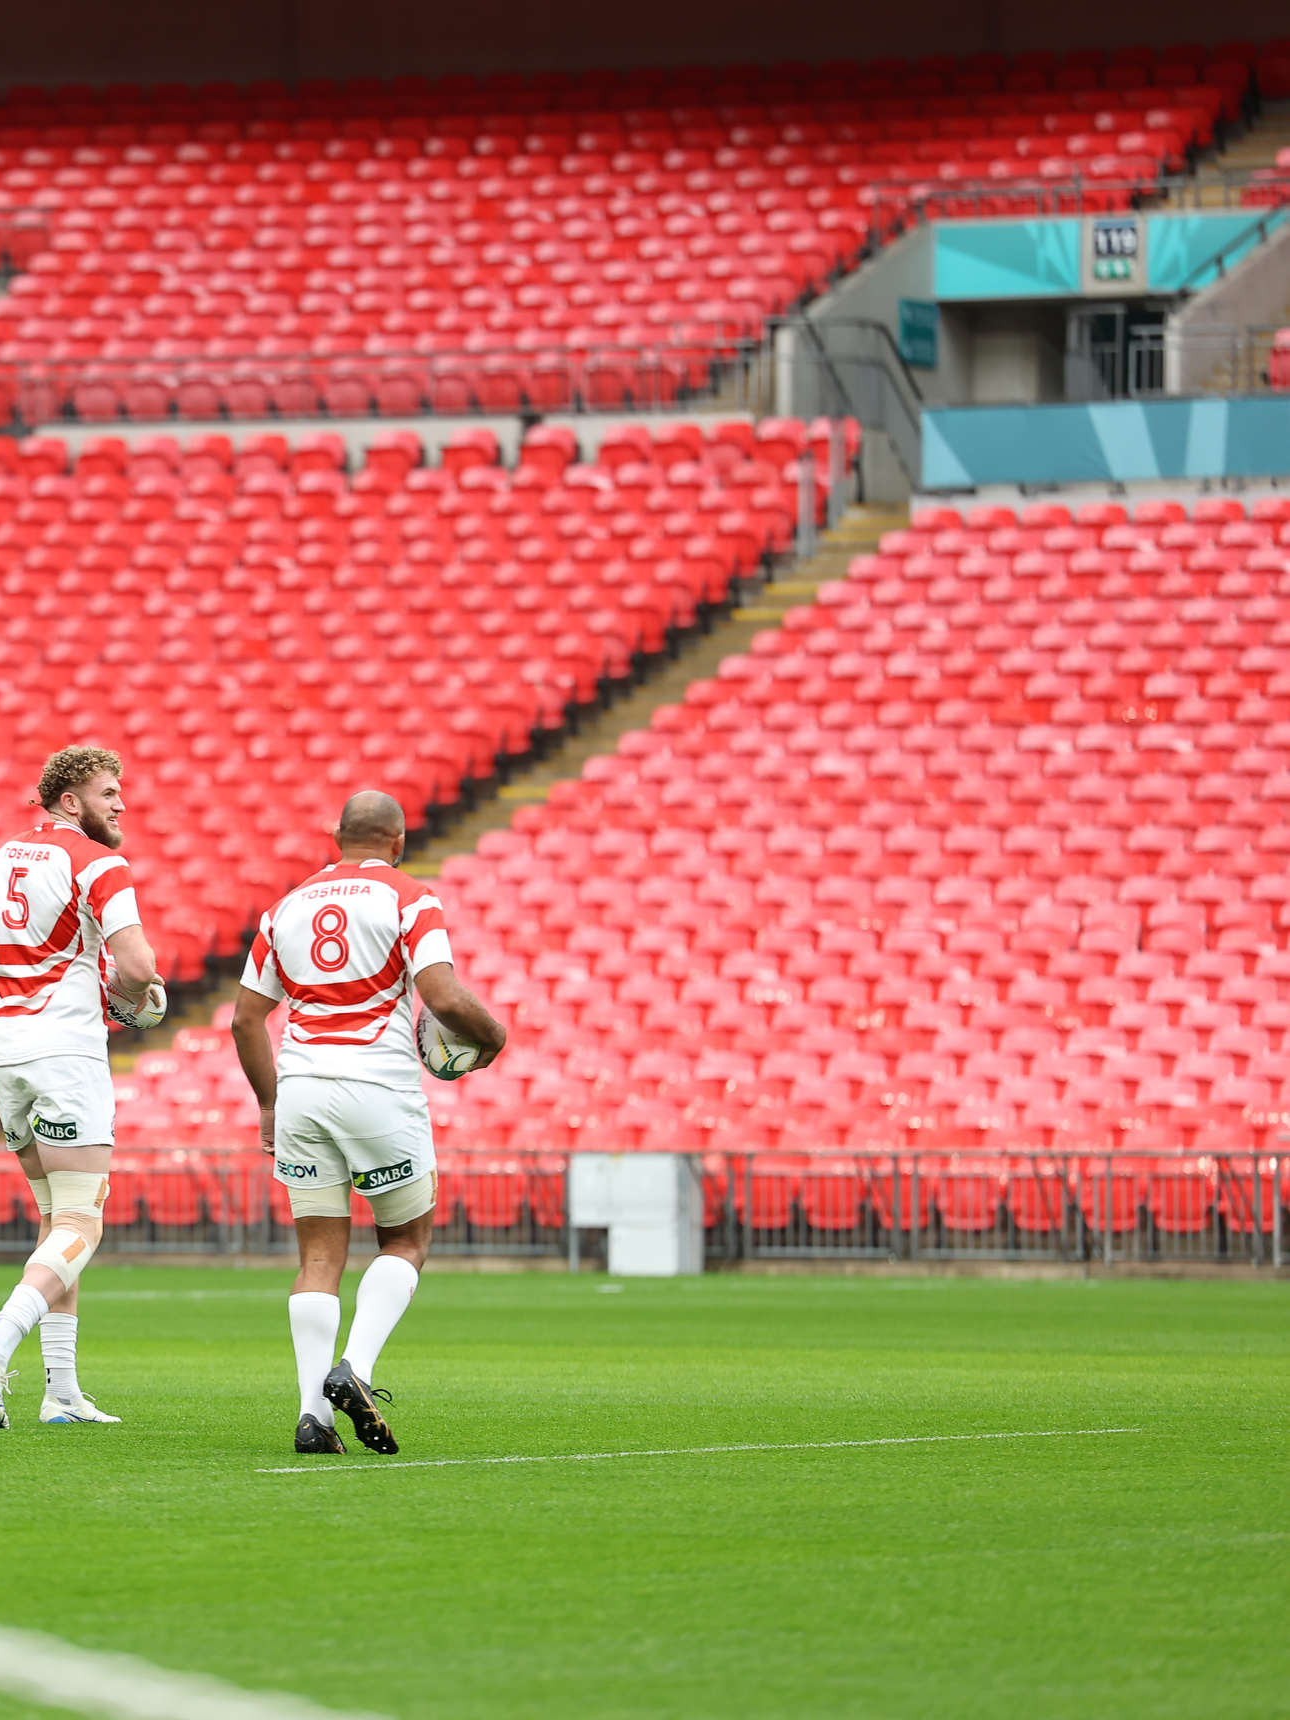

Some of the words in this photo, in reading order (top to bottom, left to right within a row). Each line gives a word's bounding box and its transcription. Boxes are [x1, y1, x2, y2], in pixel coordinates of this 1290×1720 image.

[5, 847, 50, 862] TOSHIBA
[2, 866, 30, 930] 5
[302, 885, 371, 902] TOSHIBA
[311, 904, 350, 973] 8
[39, 1121, 76, 1138] SMBC
[369, 1163, 412, 1187] SMBC
